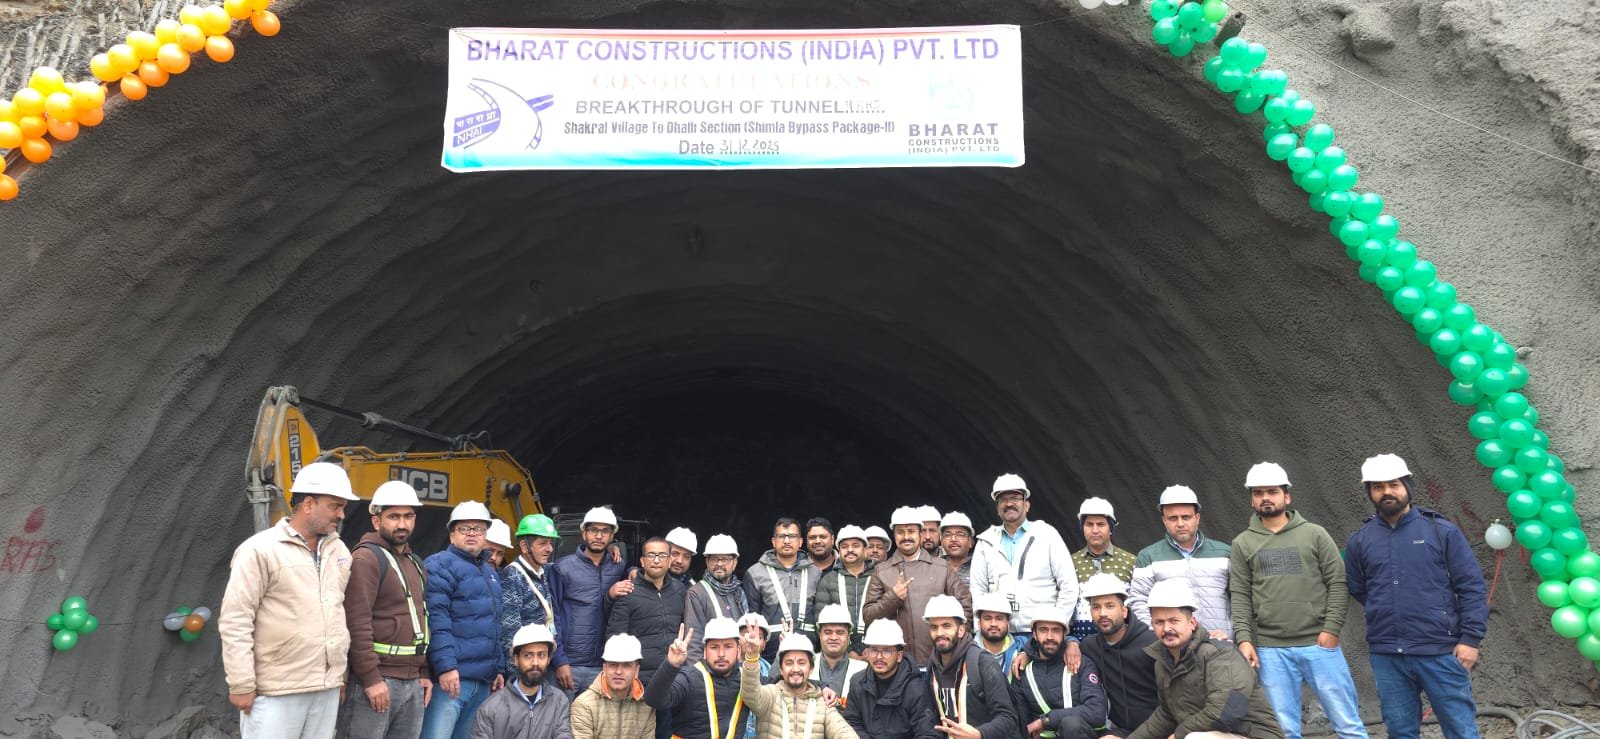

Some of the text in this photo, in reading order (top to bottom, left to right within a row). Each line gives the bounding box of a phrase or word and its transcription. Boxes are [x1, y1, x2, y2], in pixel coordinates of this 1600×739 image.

[467, 37, 999, 67] BHARAT CONSTRUCTIONS (INDIA) PVT. LTD
[575, 99, 733, 116] BREAKTHROUGH
[739, 99, 764, 115] OF
[457, 126, 483, 145] NHAI
[563, 119, 896, 136] Shakral Village To Dhalli Section (Shimla Bypass Package-II)
[908, 122, 999, 138] BHARAT
[678, 139, 715, 156] Date
[908, 137, 1000, 147] CONSTRUCTIONS
[908, 146, 948, 156] (INDIA)
[979, 145, 1000, 153] LTD
[289, 433, 302, 480] 215
